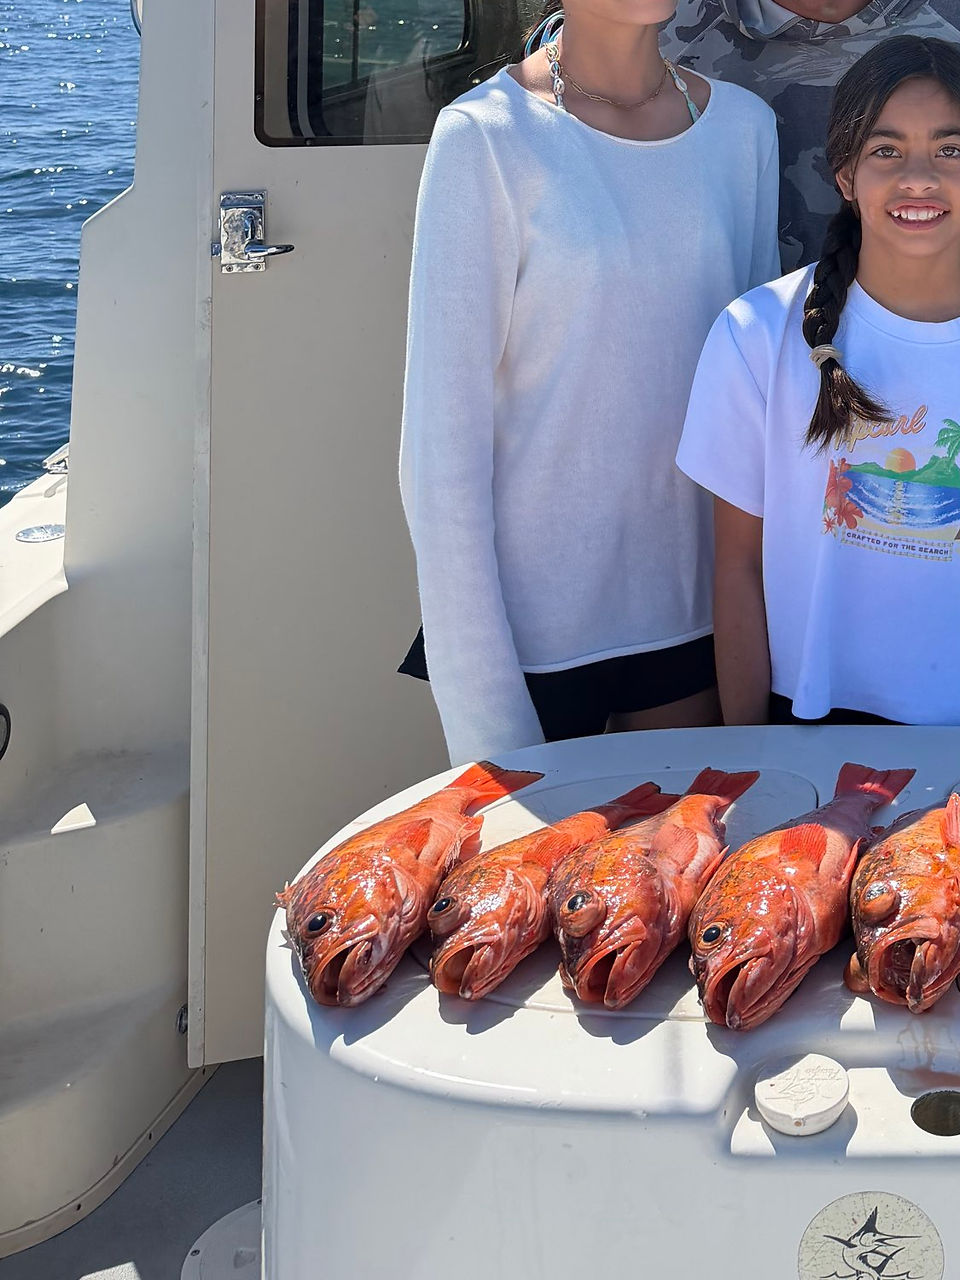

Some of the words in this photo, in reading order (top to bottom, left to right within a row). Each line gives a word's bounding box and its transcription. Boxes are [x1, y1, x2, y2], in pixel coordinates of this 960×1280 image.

[846, 532, 881, 545] CRAFTED
[883, 541, 898, 550] FOR
[902, 544, 916, 552] THE
[918, 546, 950, 556] SEARCH
